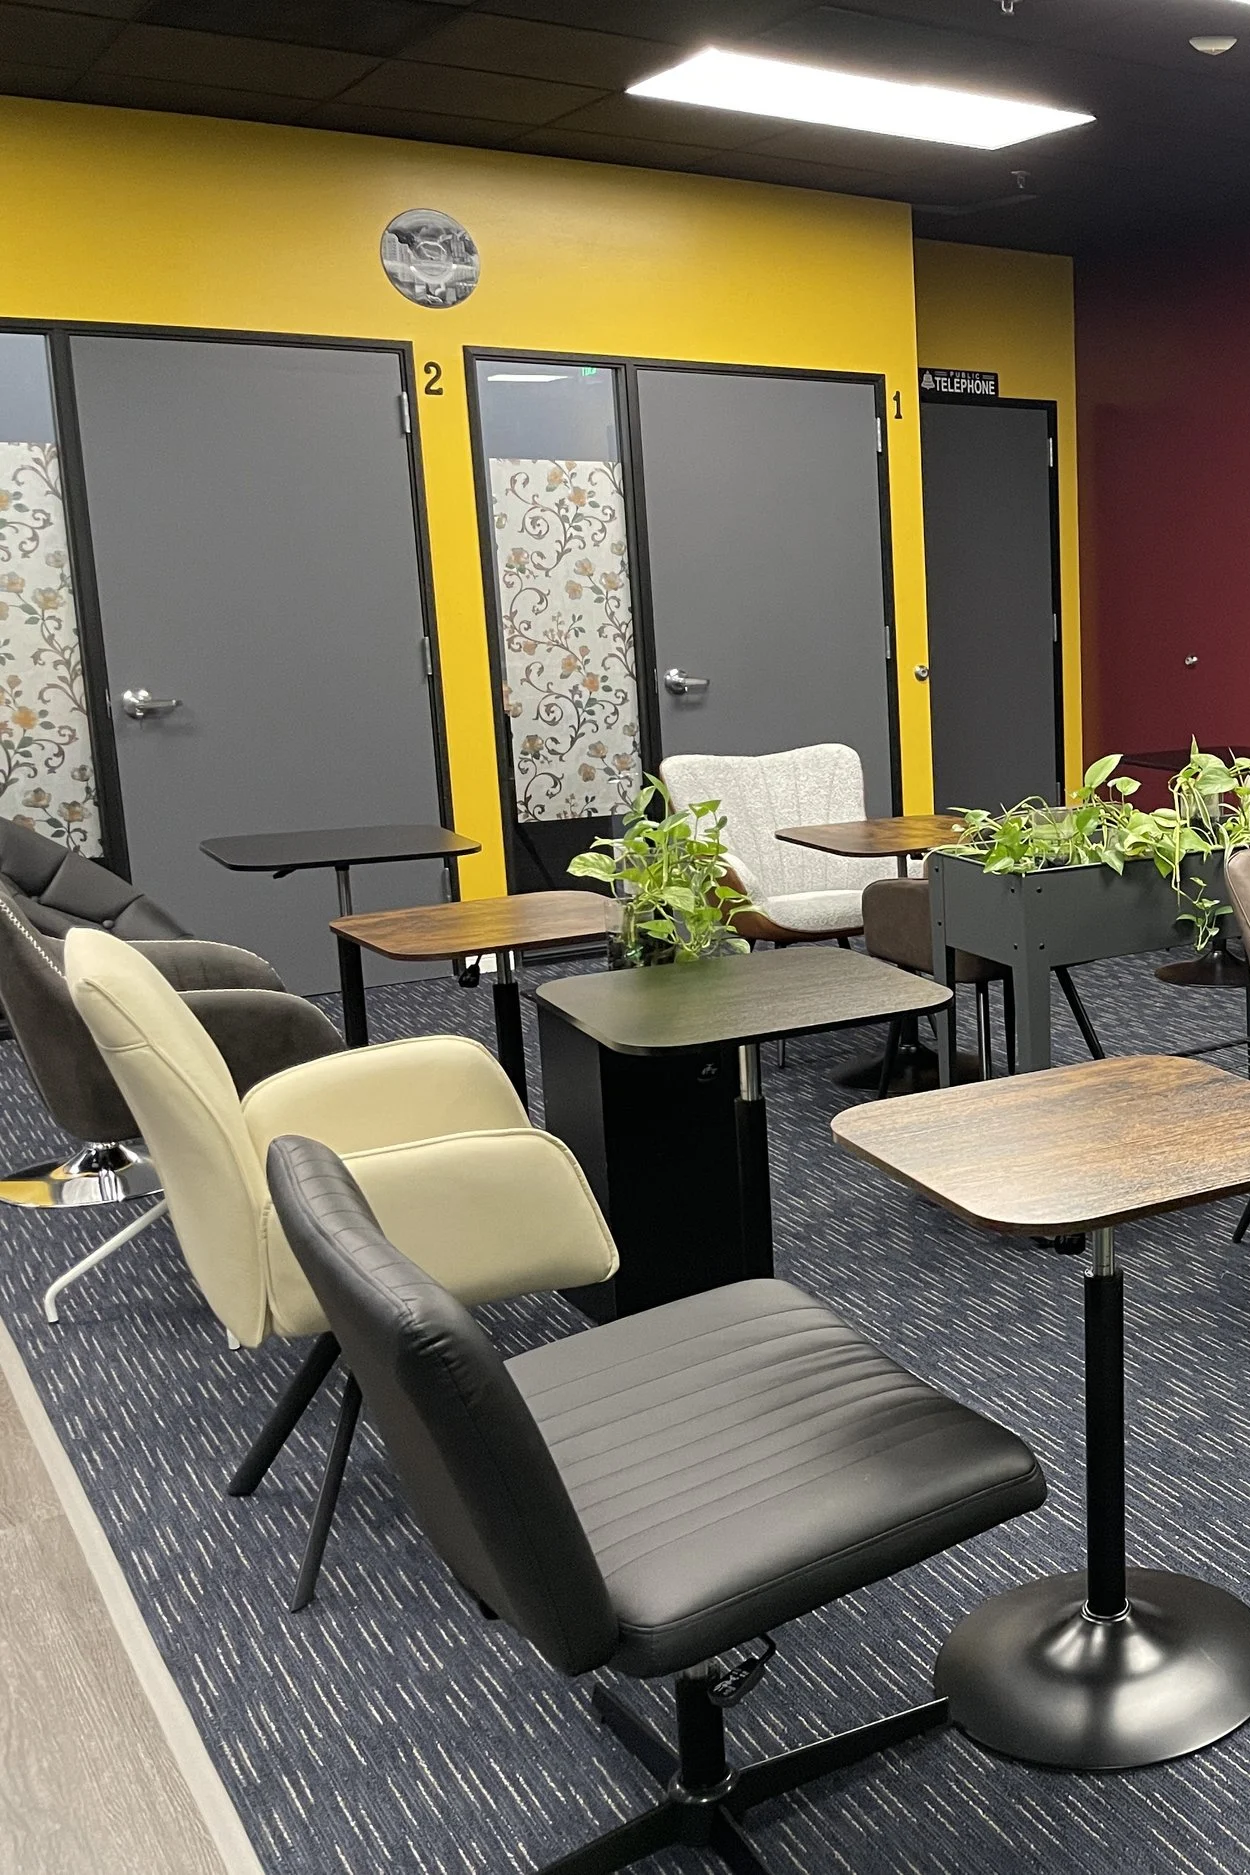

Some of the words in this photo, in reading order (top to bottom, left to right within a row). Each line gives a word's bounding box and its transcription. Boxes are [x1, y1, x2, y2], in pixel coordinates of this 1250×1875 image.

[424, 361, 443, 395] 2
[934, 376, 996, 395] TELEPHONE
[949, 371, 981, 380] PUBLIC
[893, 390, 903, 419] 1
